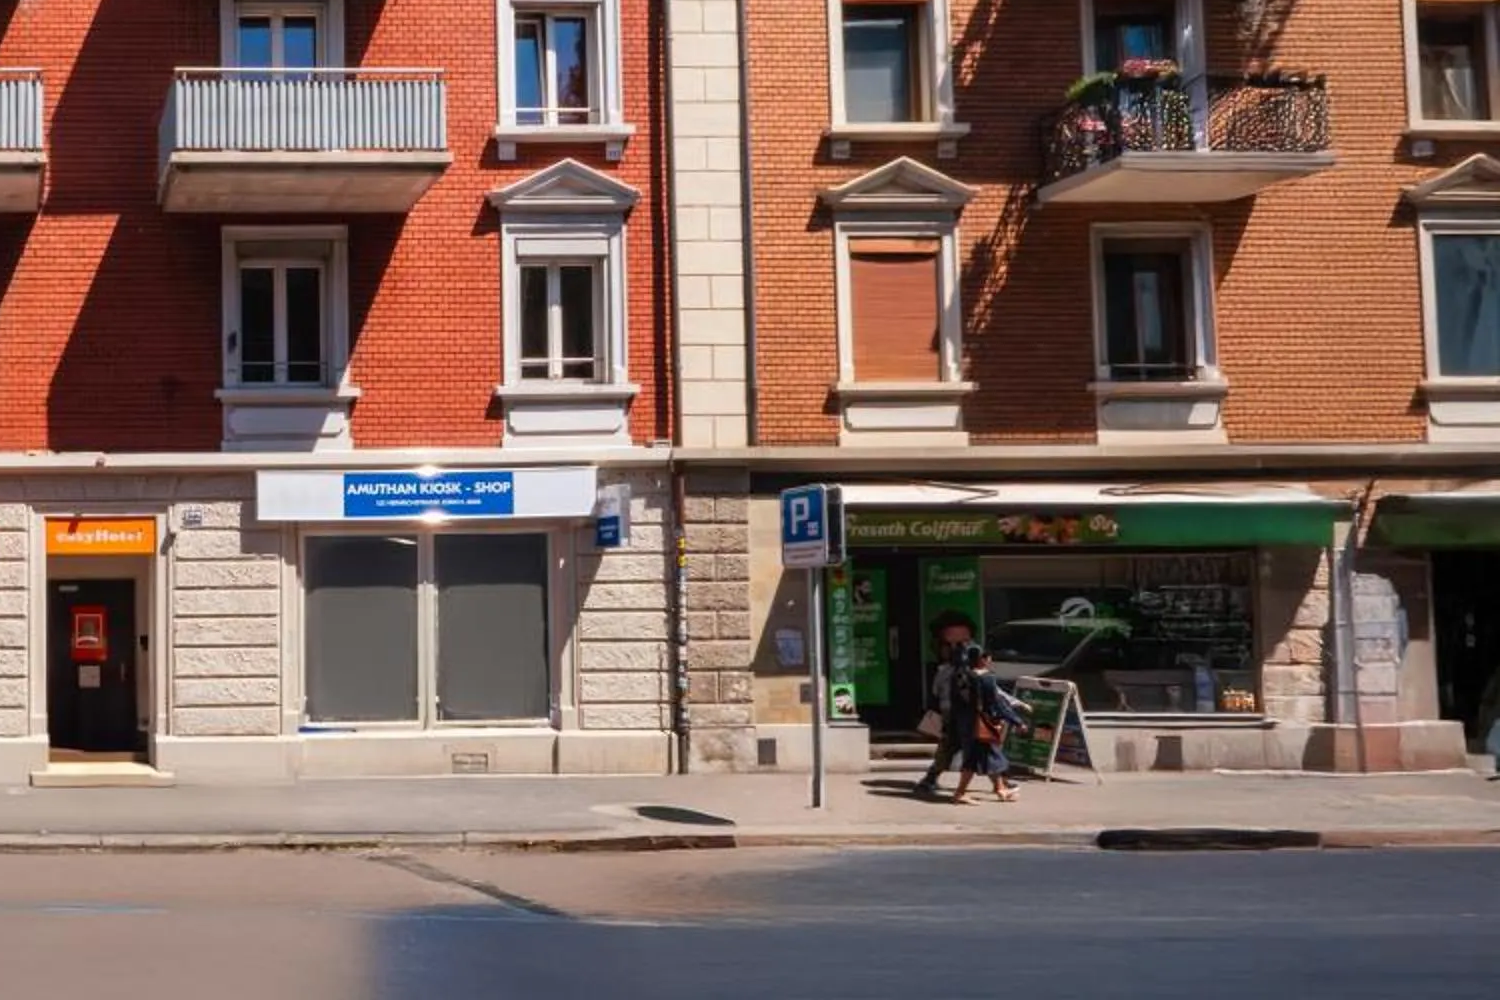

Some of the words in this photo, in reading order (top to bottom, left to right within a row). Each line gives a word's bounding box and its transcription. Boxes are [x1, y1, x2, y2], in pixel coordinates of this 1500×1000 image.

[347, 483, 417, 496] AMUTHAN
[419, 482, 461, 495] KIOSK
[475, 481, 511, 494] SHOP
[791, 497, 810, 536] P
